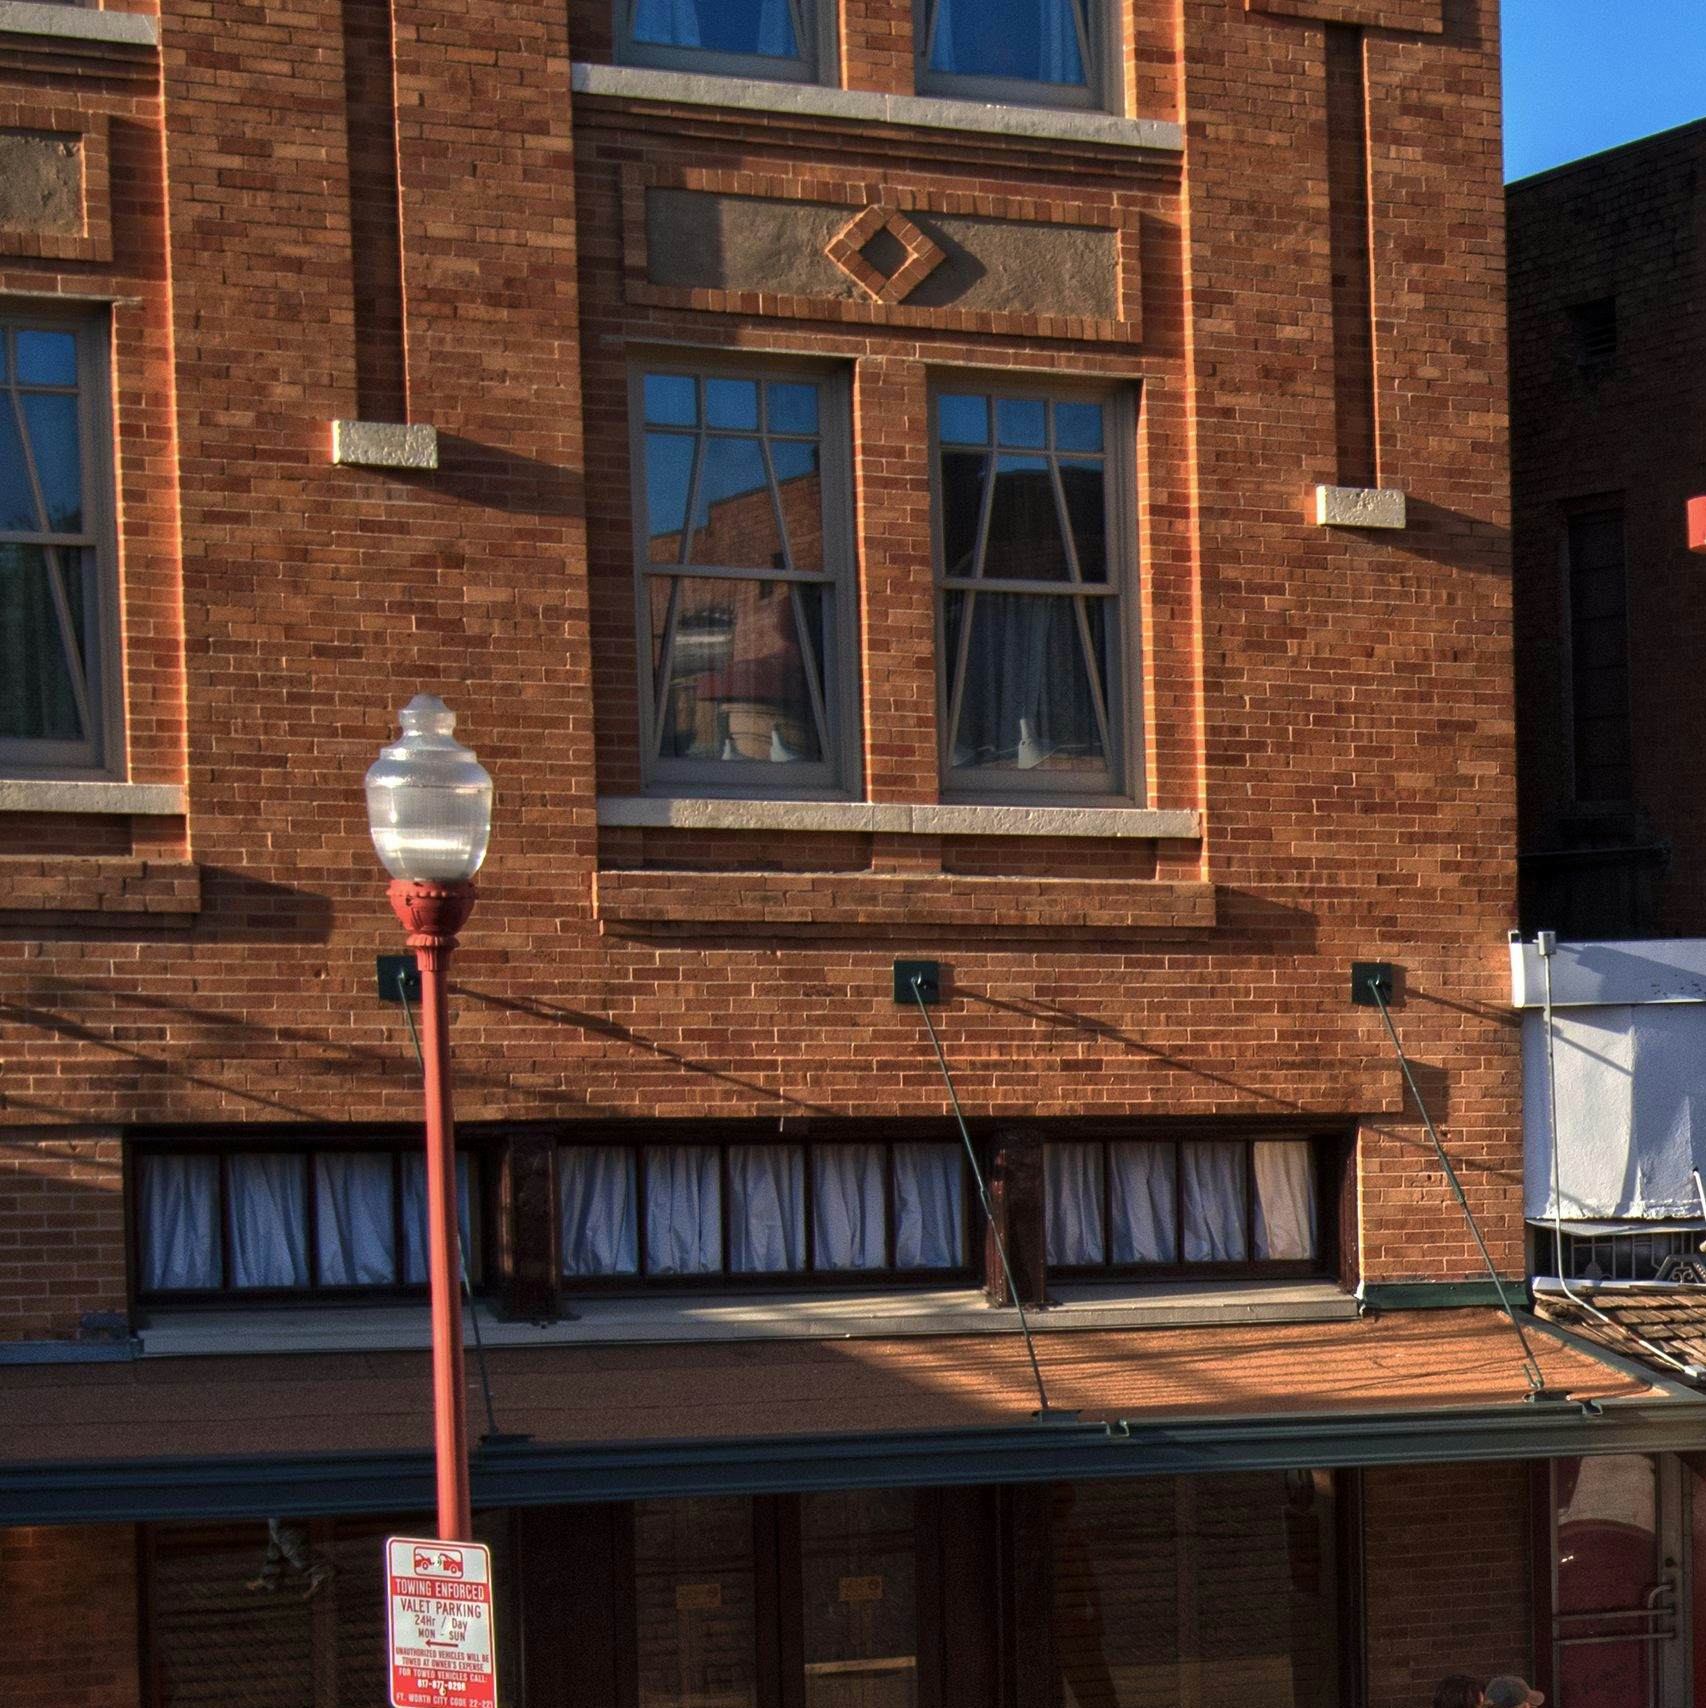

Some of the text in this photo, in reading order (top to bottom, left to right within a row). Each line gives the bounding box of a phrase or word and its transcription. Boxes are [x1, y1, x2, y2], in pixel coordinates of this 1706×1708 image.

[396, 1579, 485, 1600] TOWING ENFORCED
[400, 1598, 482, 1618] VALET PARKING
[414, 1615, 436, 1627] 24Hr
[452, 1617, 468, 1632] Day
[418, 1627, 436, 1638] MON
[448, 1630, 466, 1642] SUN
[396, 1647, 490, 1663] UNAUTHORIZED VEHICLES WILL BE
[401, 1657, 421, 1667] TOWED
[458, 1662, 485, 1672] EXPENSE
[399, 1667, 411, 1676] FOR
[413, 1668, 435, 1678] TOWED
[437, 1670, 468, 1681] VEHICLES
[408, 1694, 432, 1704] WORTH
[433, 1696, 448, 1705] CITY
[450, 1697, 468, 1707] CODE
